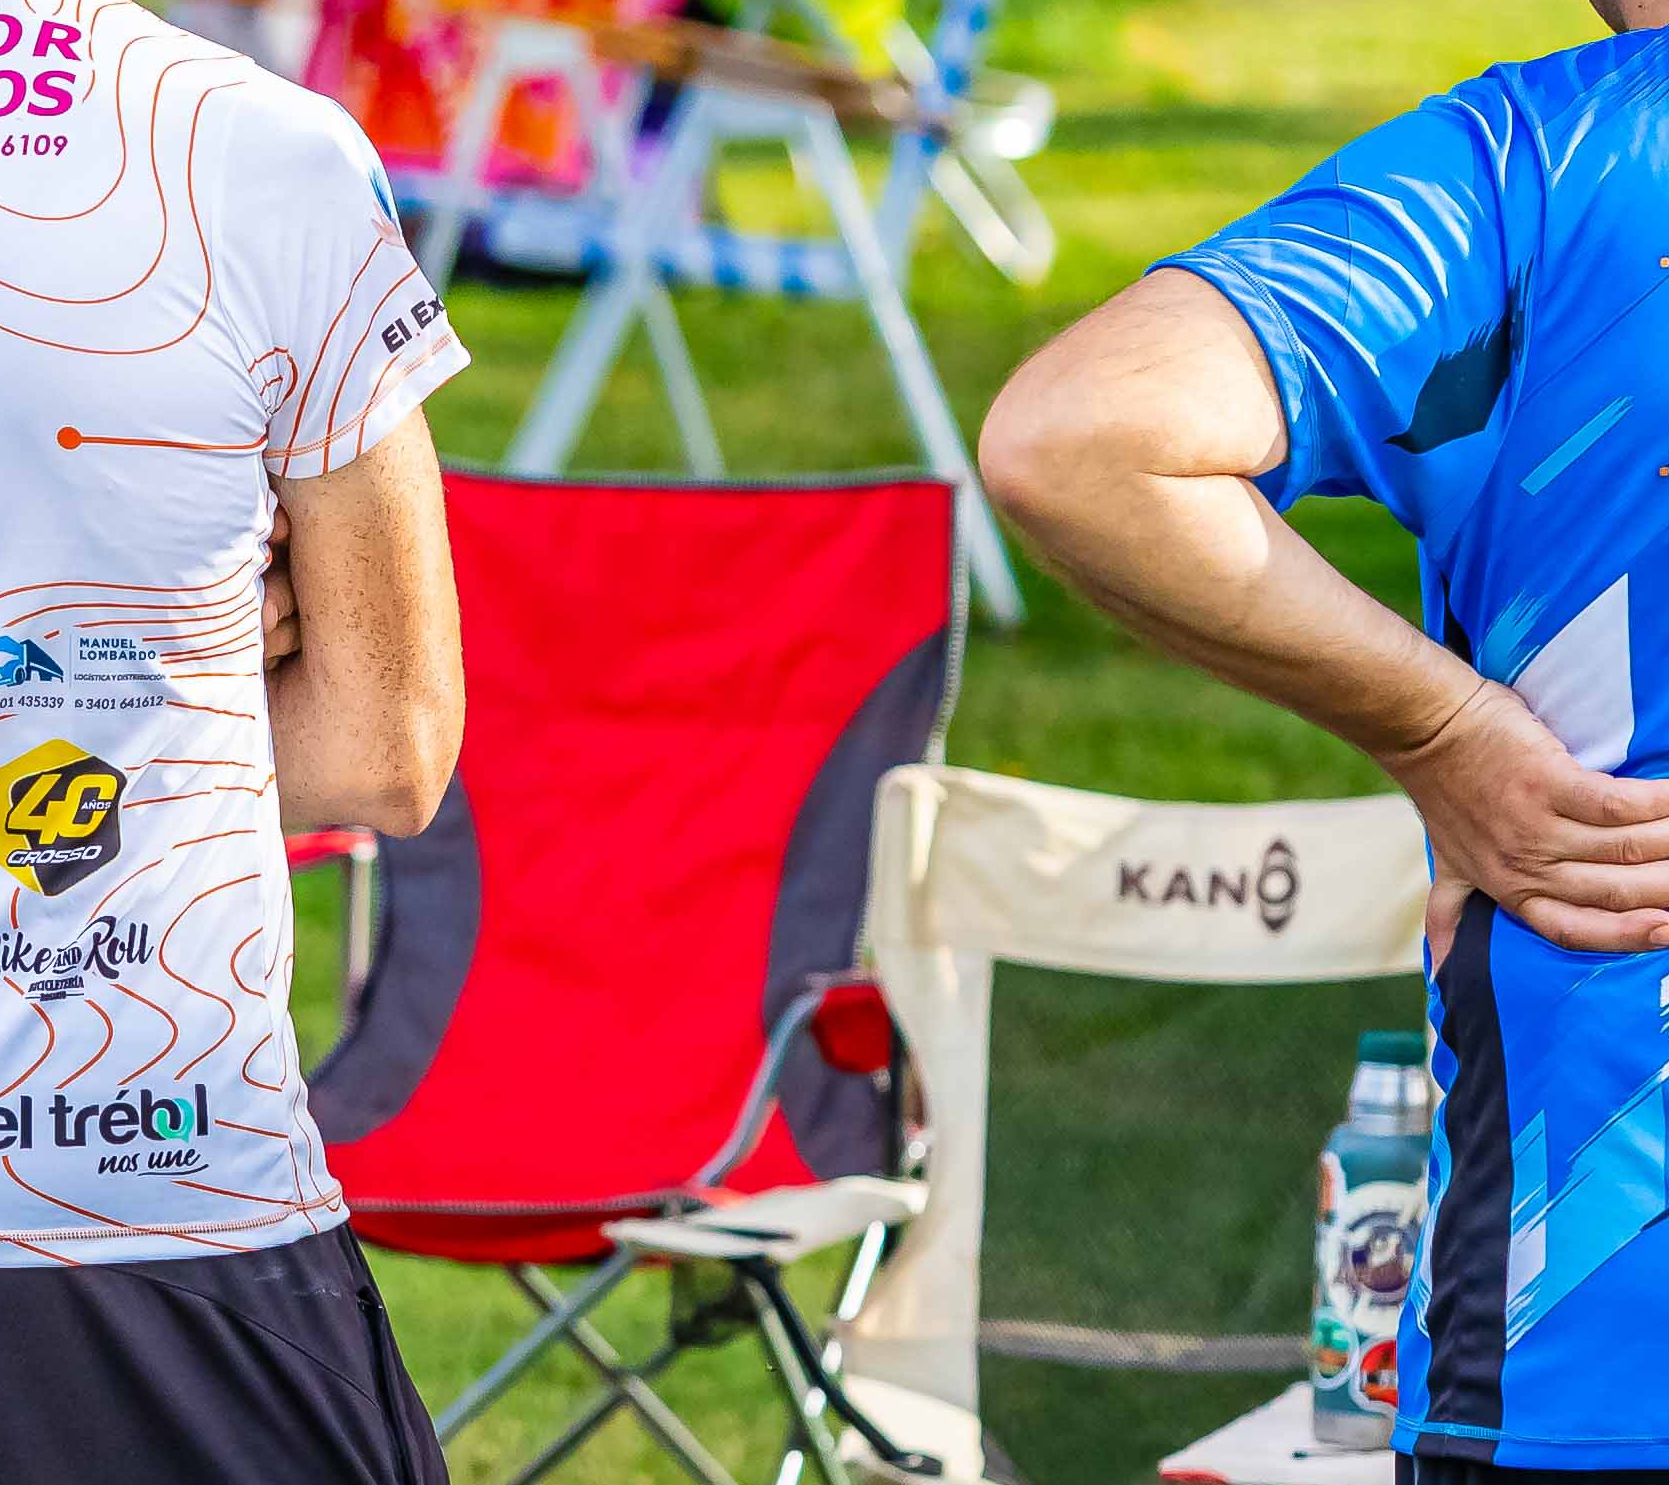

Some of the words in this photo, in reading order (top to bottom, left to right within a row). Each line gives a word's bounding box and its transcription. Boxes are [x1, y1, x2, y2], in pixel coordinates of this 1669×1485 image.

[79, 637, 137, 649] MANUEL
[79, 649, 157, 661] LOMBARDO
[17, 695, 65, 709] 435339
[85, 698, 117, 710] 3401
[119, 695, 164, 710] 641612
[7, 773, 118, 845] 40
[81, 799, 112, 811] AÑOS
[7, 845, 103, 865] GROSSO
[80, 915, 155, 980] Roll
[48, 1083, 209, 1148] trébol
[97, 1152, 141, 1175] nos
[147, 1148, 202, 1170] une
